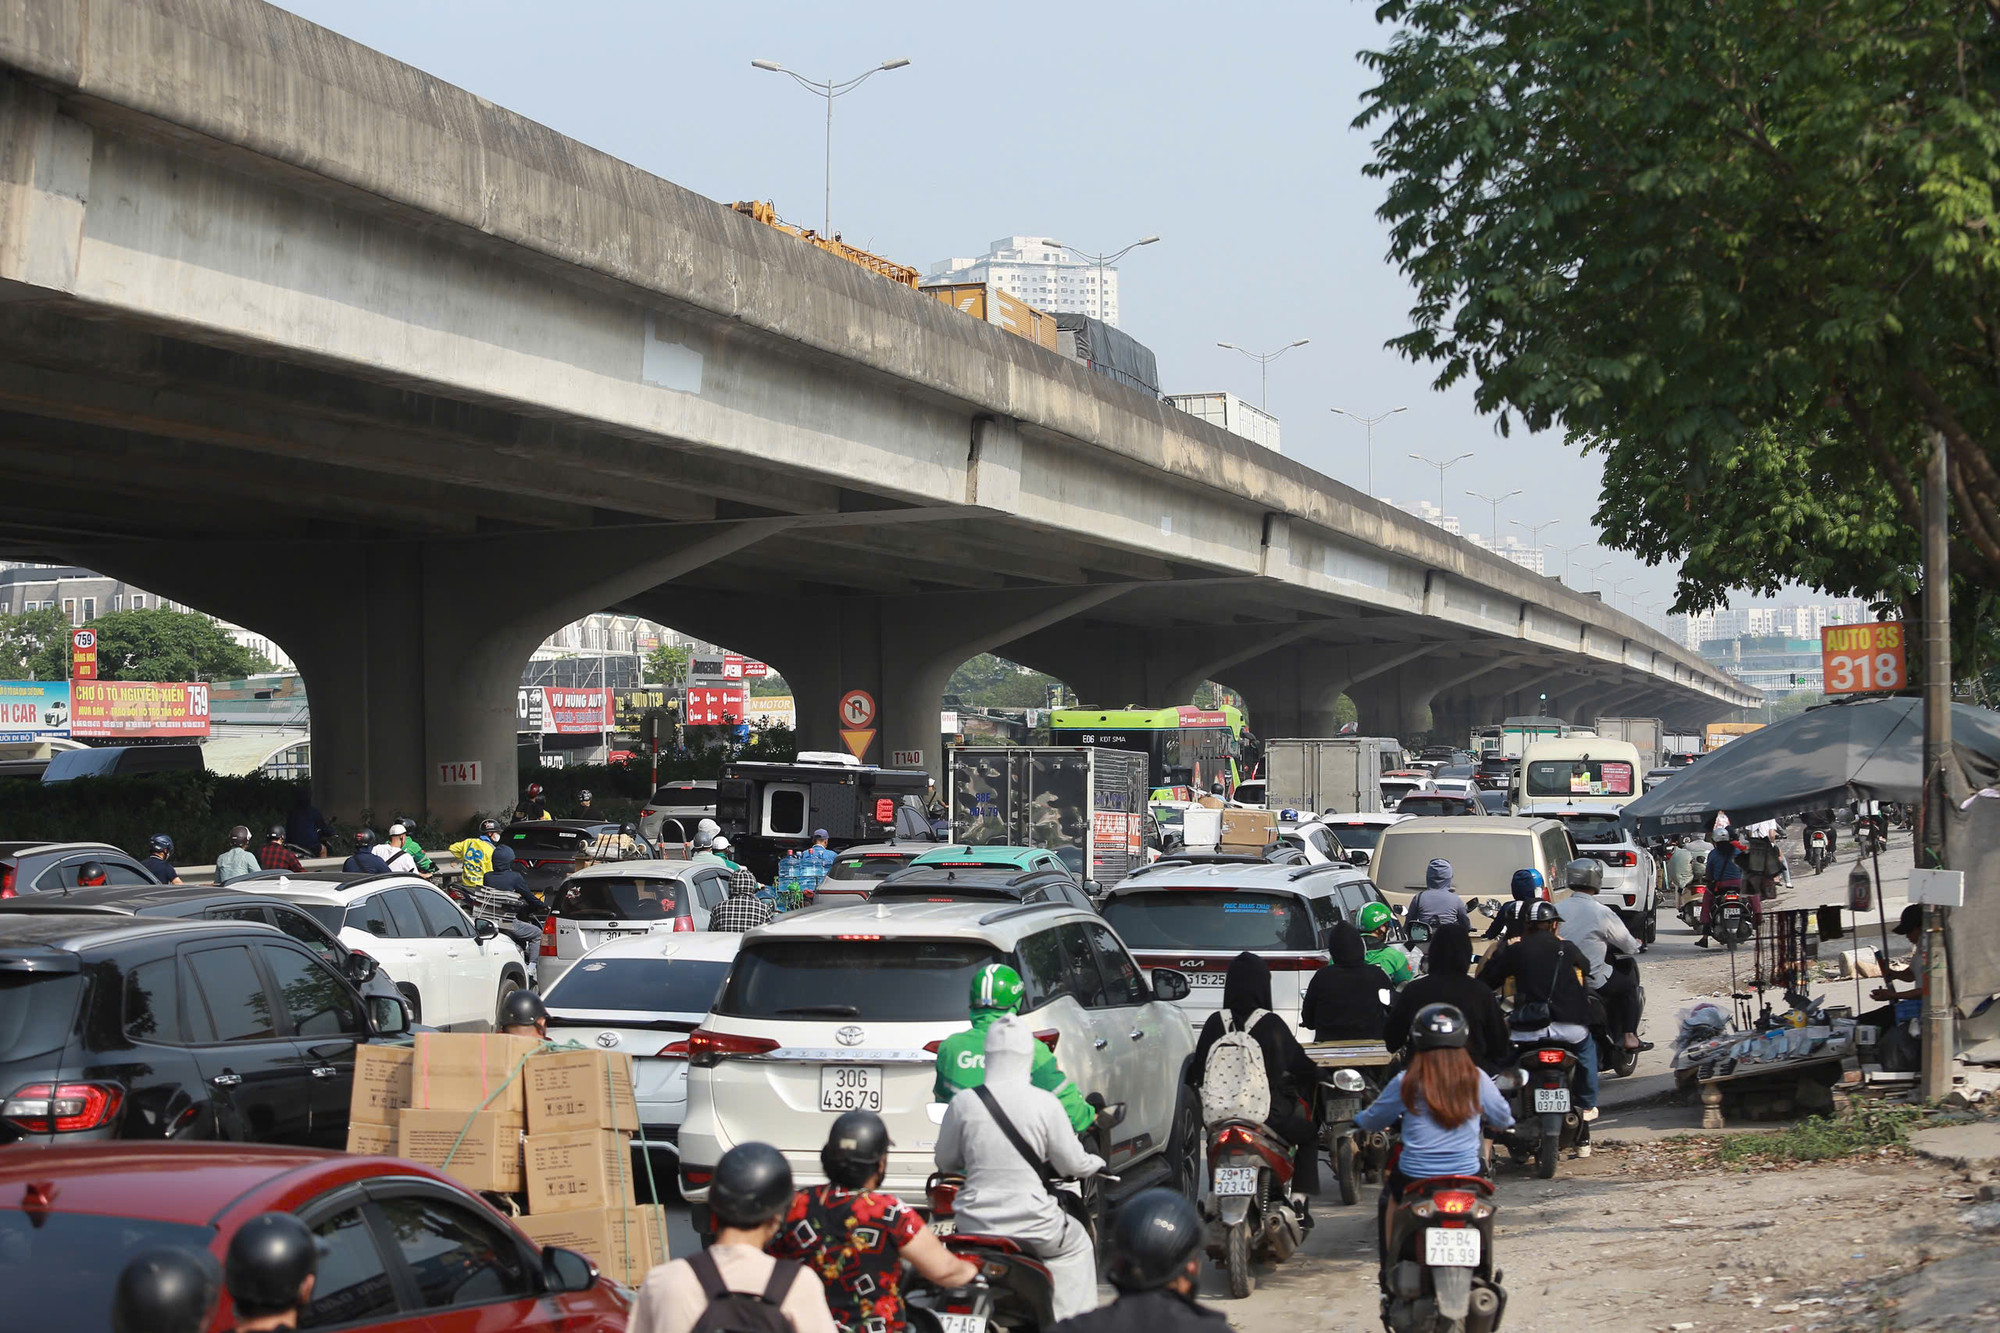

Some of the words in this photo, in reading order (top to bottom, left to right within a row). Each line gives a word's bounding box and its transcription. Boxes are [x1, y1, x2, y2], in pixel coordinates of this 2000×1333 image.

[77, 633, 92, 645] 759
[1826, 627, 1870, 651] AUTO
[1876, 626, 1899, 648] 3S
[80, 666, 90, 675] AUTO
[1830, 653, 1898, 689] 318
[75, 685, 95, 704] CHỢ
[97, 684, 104, 700] Ô
[106, 685, 118, 700] TÔ
[187, 685, 208, 716] 759
[565, 691, 586, 707] HÙNG
[760, 700, 791, 708] MOTOR
[12, 704, 37, 722] CAR
[1083, 735, 1095, 744] E06
[895, 751, 920, 764] T140
[441, 764, 476, 782] T141
[1373, 913, 1388, 923] Grab
[836, 1069, 868, 1088] 30G
[823, 1090, 880, 1110] 436.79
[1537, 1101, 1567, 1111] 037.07
[1216, 1180, 1254, 1194] 323.40
[1434, 1231, 1471, 1247] 36-B4
[1430, 1247, 1476, 1263] 716.99
